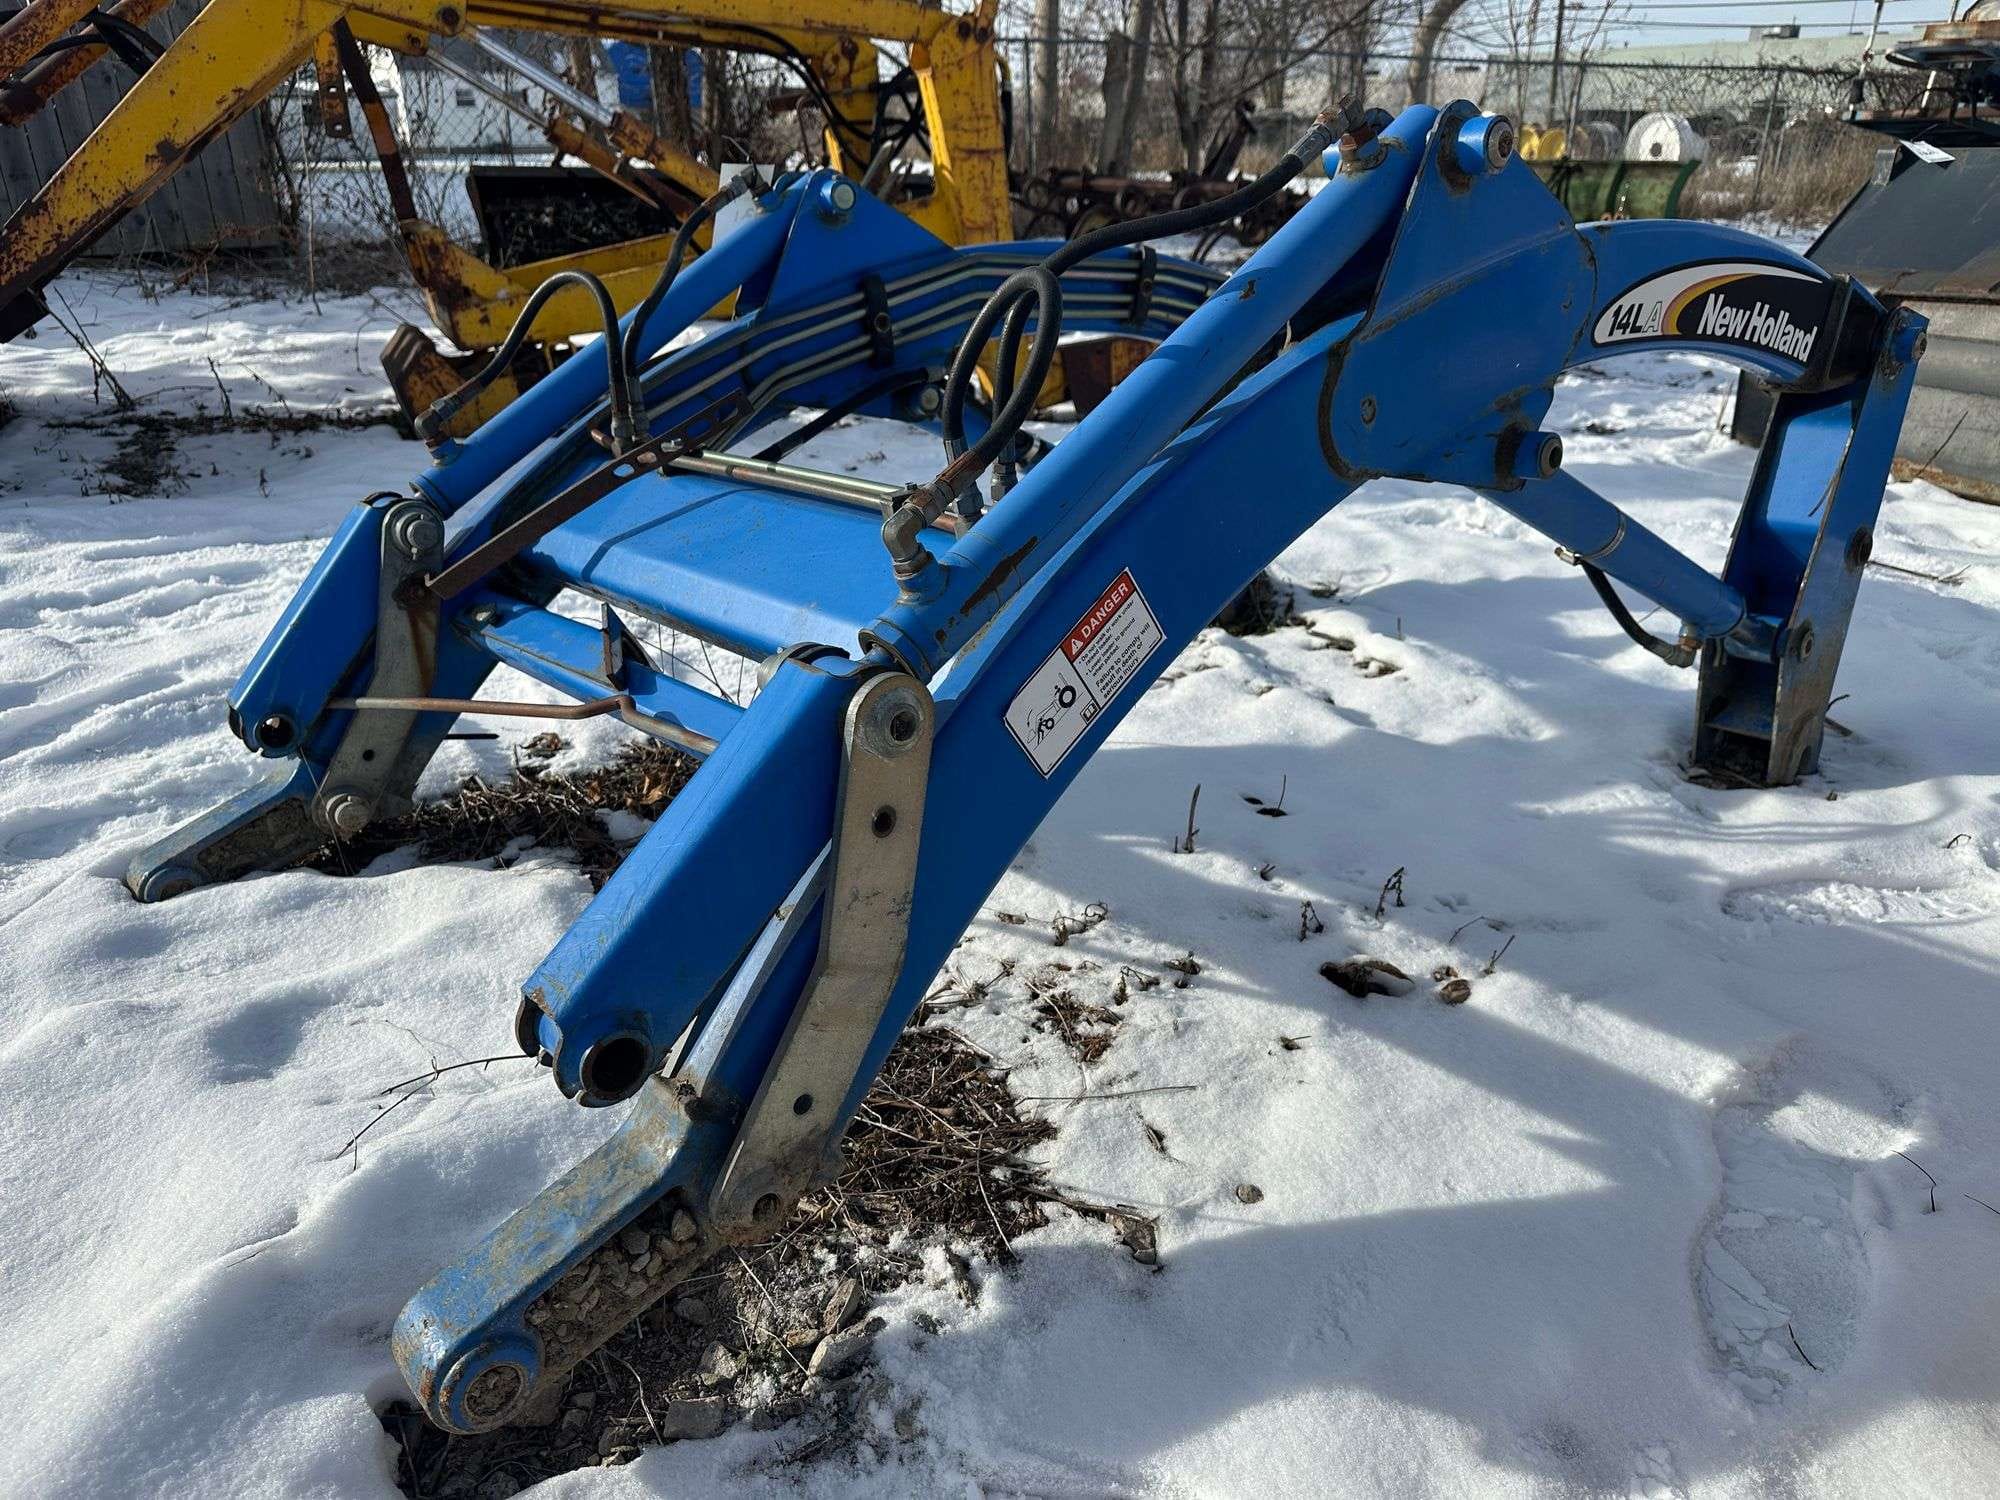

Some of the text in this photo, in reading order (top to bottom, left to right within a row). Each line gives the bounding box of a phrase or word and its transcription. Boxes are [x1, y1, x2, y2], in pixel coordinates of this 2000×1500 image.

[1607, 301, 1663, 337] 14LA
[1697, 293, 1818, 363] New Holland
[1081, 581, 1128, 638] DANGER
[1081, 652, 1088, 661] Do
[1087, 643, 1096, 653] not
[1110, 613, 1121, 627] work
[1121, 599, 1134, 614] under
[1085, 648, 1099, 666] raised
[1087, 655, 1102, 673] Lower
[1114, 634, 1120, 642] to
[1119, 617, 1136, 637] ground
[1091, 661, 1104, 676] when
[1095, 621, 1150, 687] Failure to comply will
[1098, 640, 1144, 693] result in death or
[1102, 674, 1124, 698] serious
